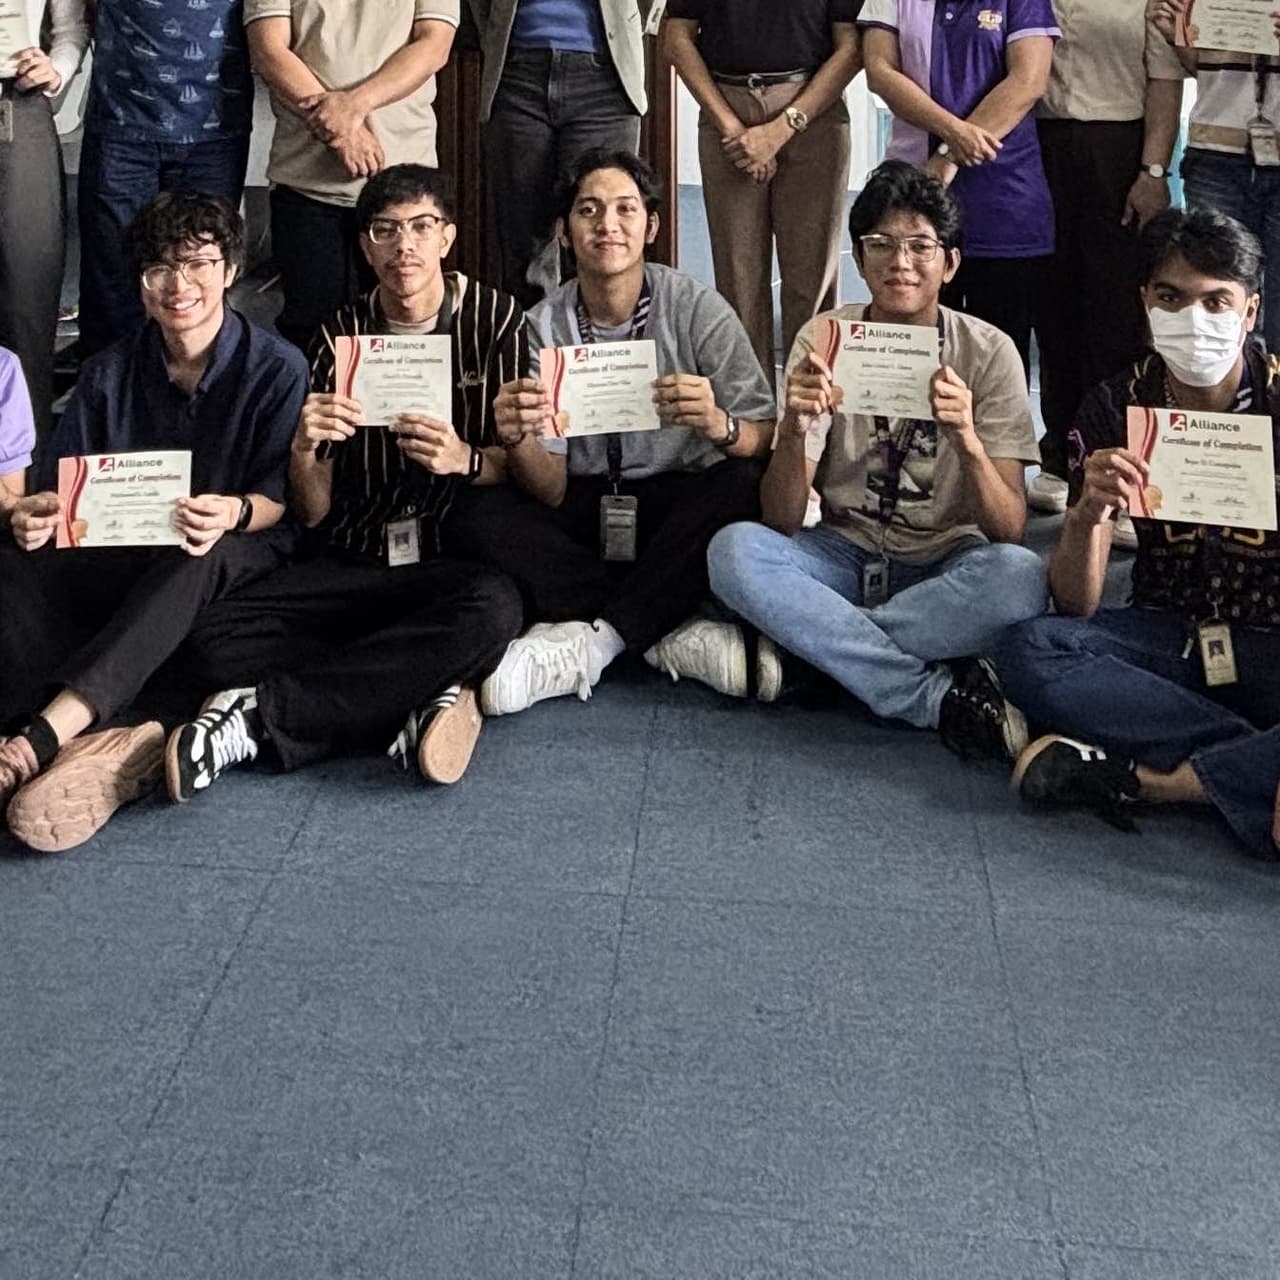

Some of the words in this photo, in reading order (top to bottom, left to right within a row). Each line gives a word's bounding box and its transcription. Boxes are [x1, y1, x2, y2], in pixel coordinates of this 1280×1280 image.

[868, 329, 911, 340] Alliance
[386, 341, 426, 350] Alliance
[591, 348, 631, 358] Alliance
[1190, 419, 1240, 432] Alliance
[117, 459, 163, 468] Alliance
